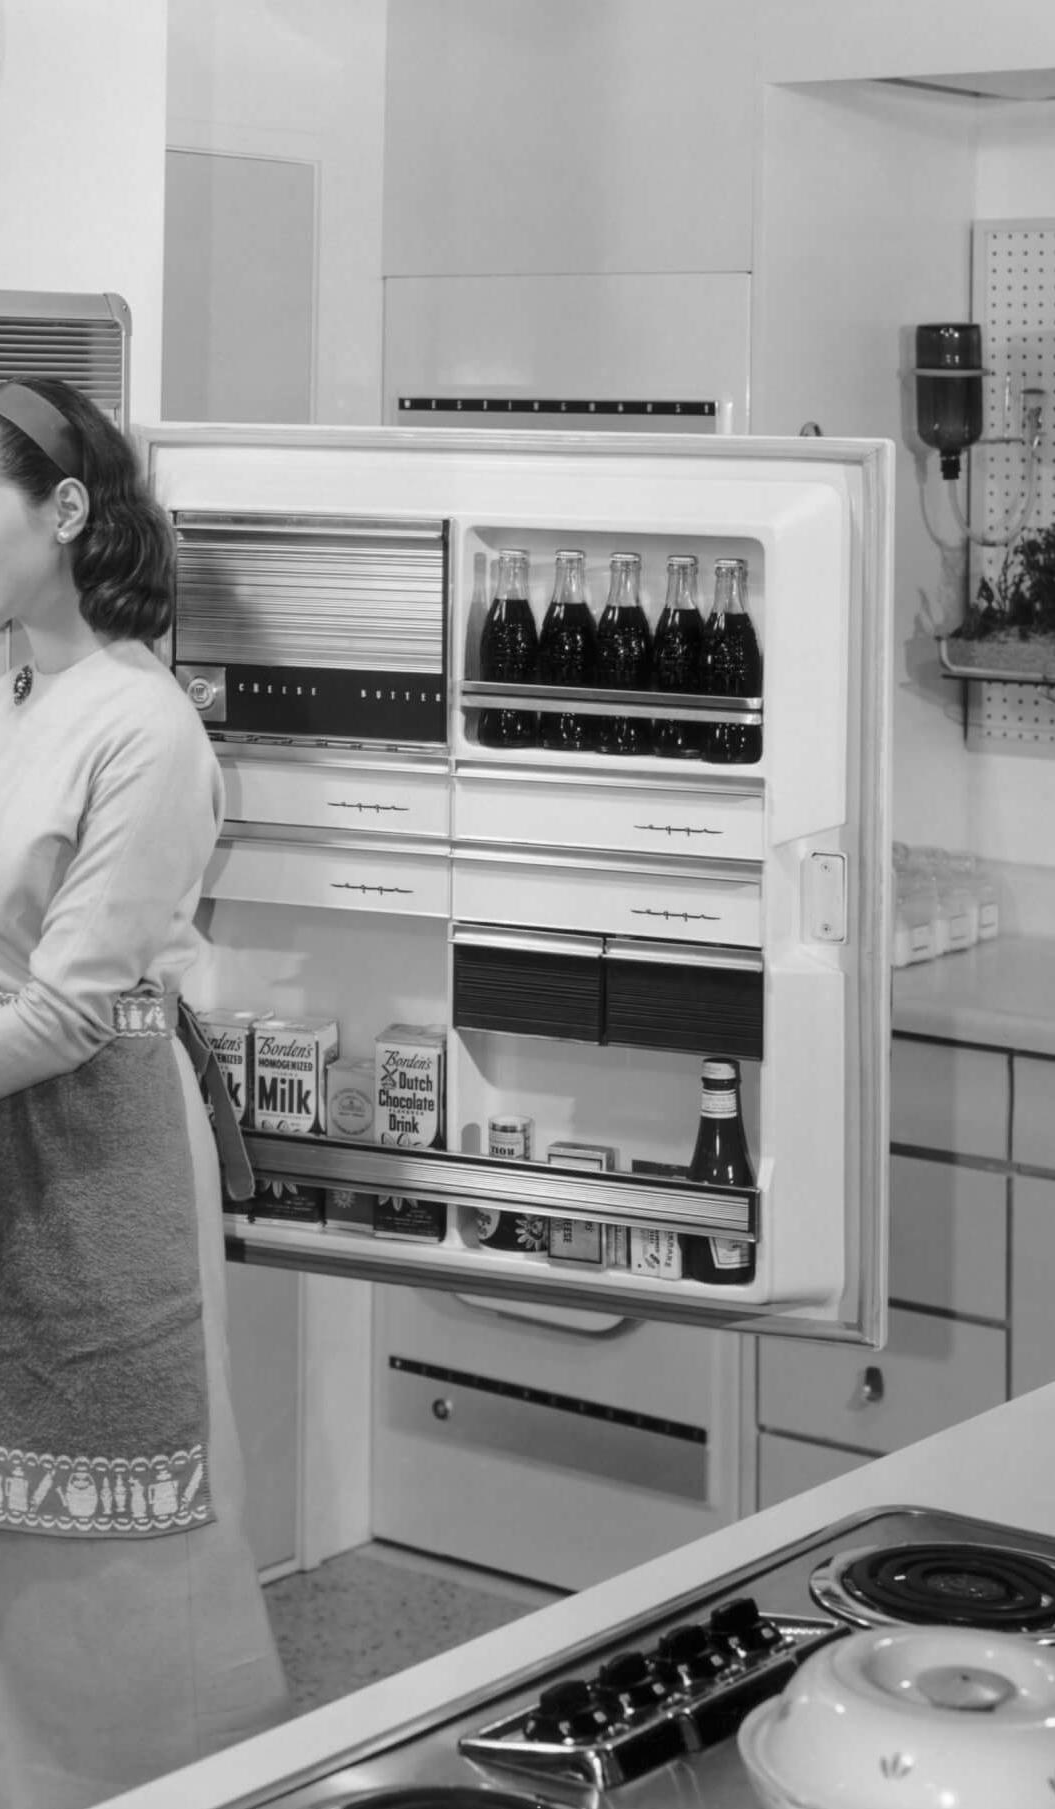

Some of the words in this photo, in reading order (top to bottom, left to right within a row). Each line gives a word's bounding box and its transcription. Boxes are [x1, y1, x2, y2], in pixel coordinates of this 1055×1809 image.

[239, 682, 316, 697] CHEESE
[361, 688, 442, 703] BUTTER
[207, 1032, 243, 1051] rden's
[257, 1036, 313, 1059] Borden's
[258, 1058, 313, 1071] HOMOGENIZED
[384, 1050, 432, 1070] Borden's
[399, 1072, 433, 1092] Dutch
[258, 1075, 312, 1115] Milk
[379, 1089, 435, 1112] Chocolate
[388, 1114, 420, 1134] Drink
